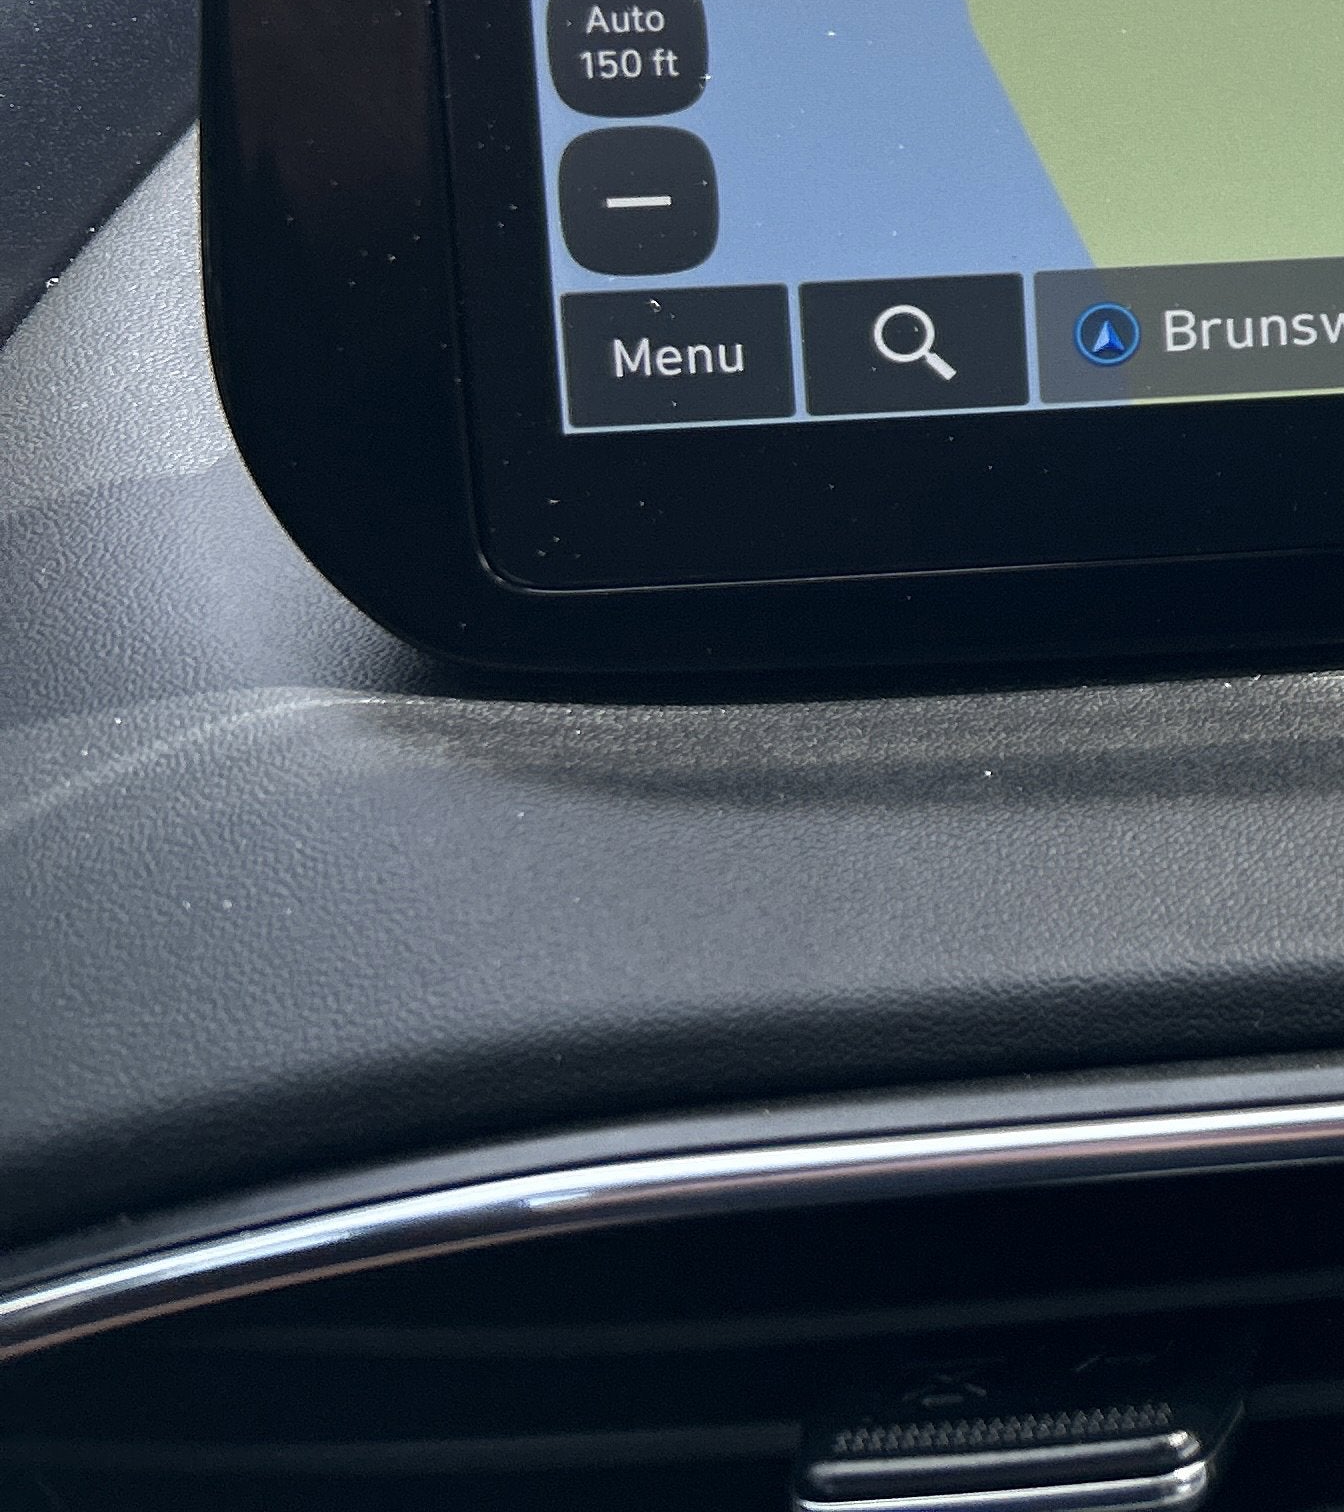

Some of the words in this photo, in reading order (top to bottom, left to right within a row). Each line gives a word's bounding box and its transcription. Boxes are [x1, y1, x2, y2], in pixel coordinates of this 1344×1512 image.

[586, 5, 665, 35] Auto
[579, 49, 642, 79] 150
[652, 47, 679, 78] ft
[612, 337, 745, 378] Menu
